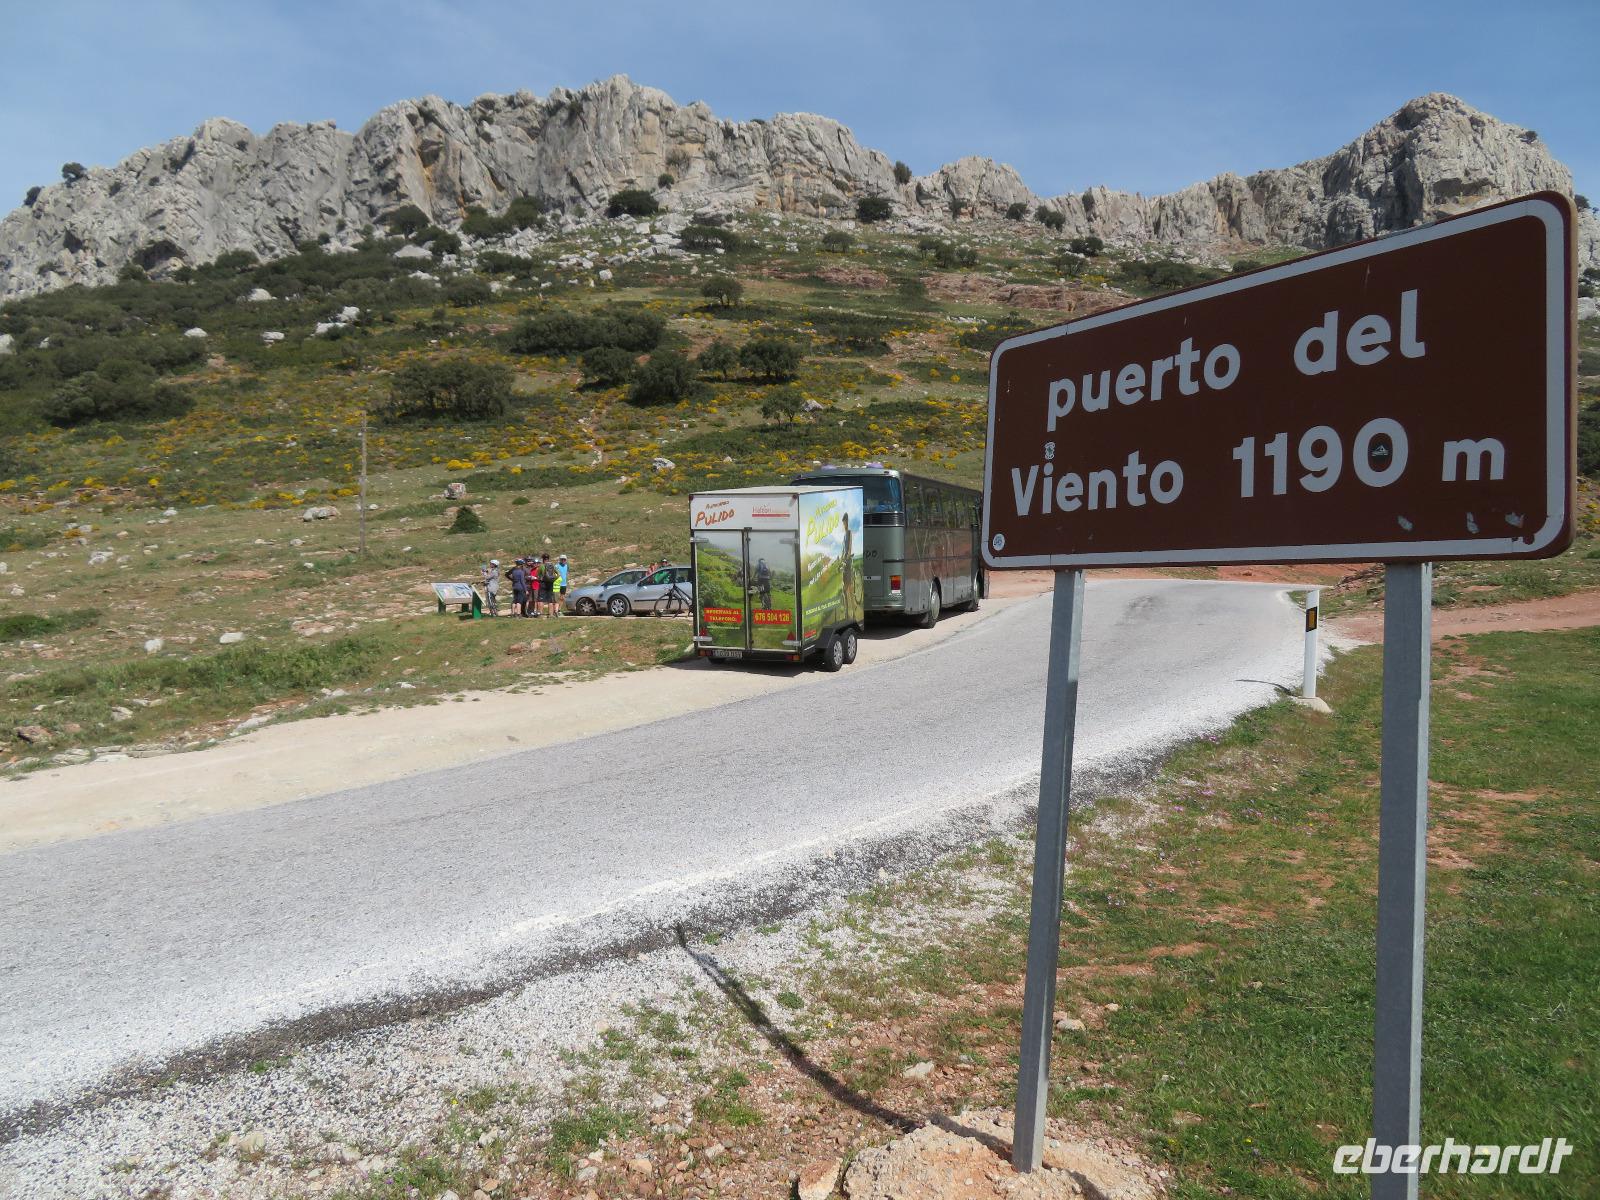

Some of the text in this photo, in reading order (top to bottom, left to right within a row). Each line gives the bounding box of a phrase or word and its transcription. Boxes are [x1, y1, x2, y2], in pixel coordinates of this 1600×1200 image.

[1046, 289, 1426, 432] puerto del
[1011, 417, 1505, 517] Viento 1190 m
[694, 508, 735, 527] PULIDO
